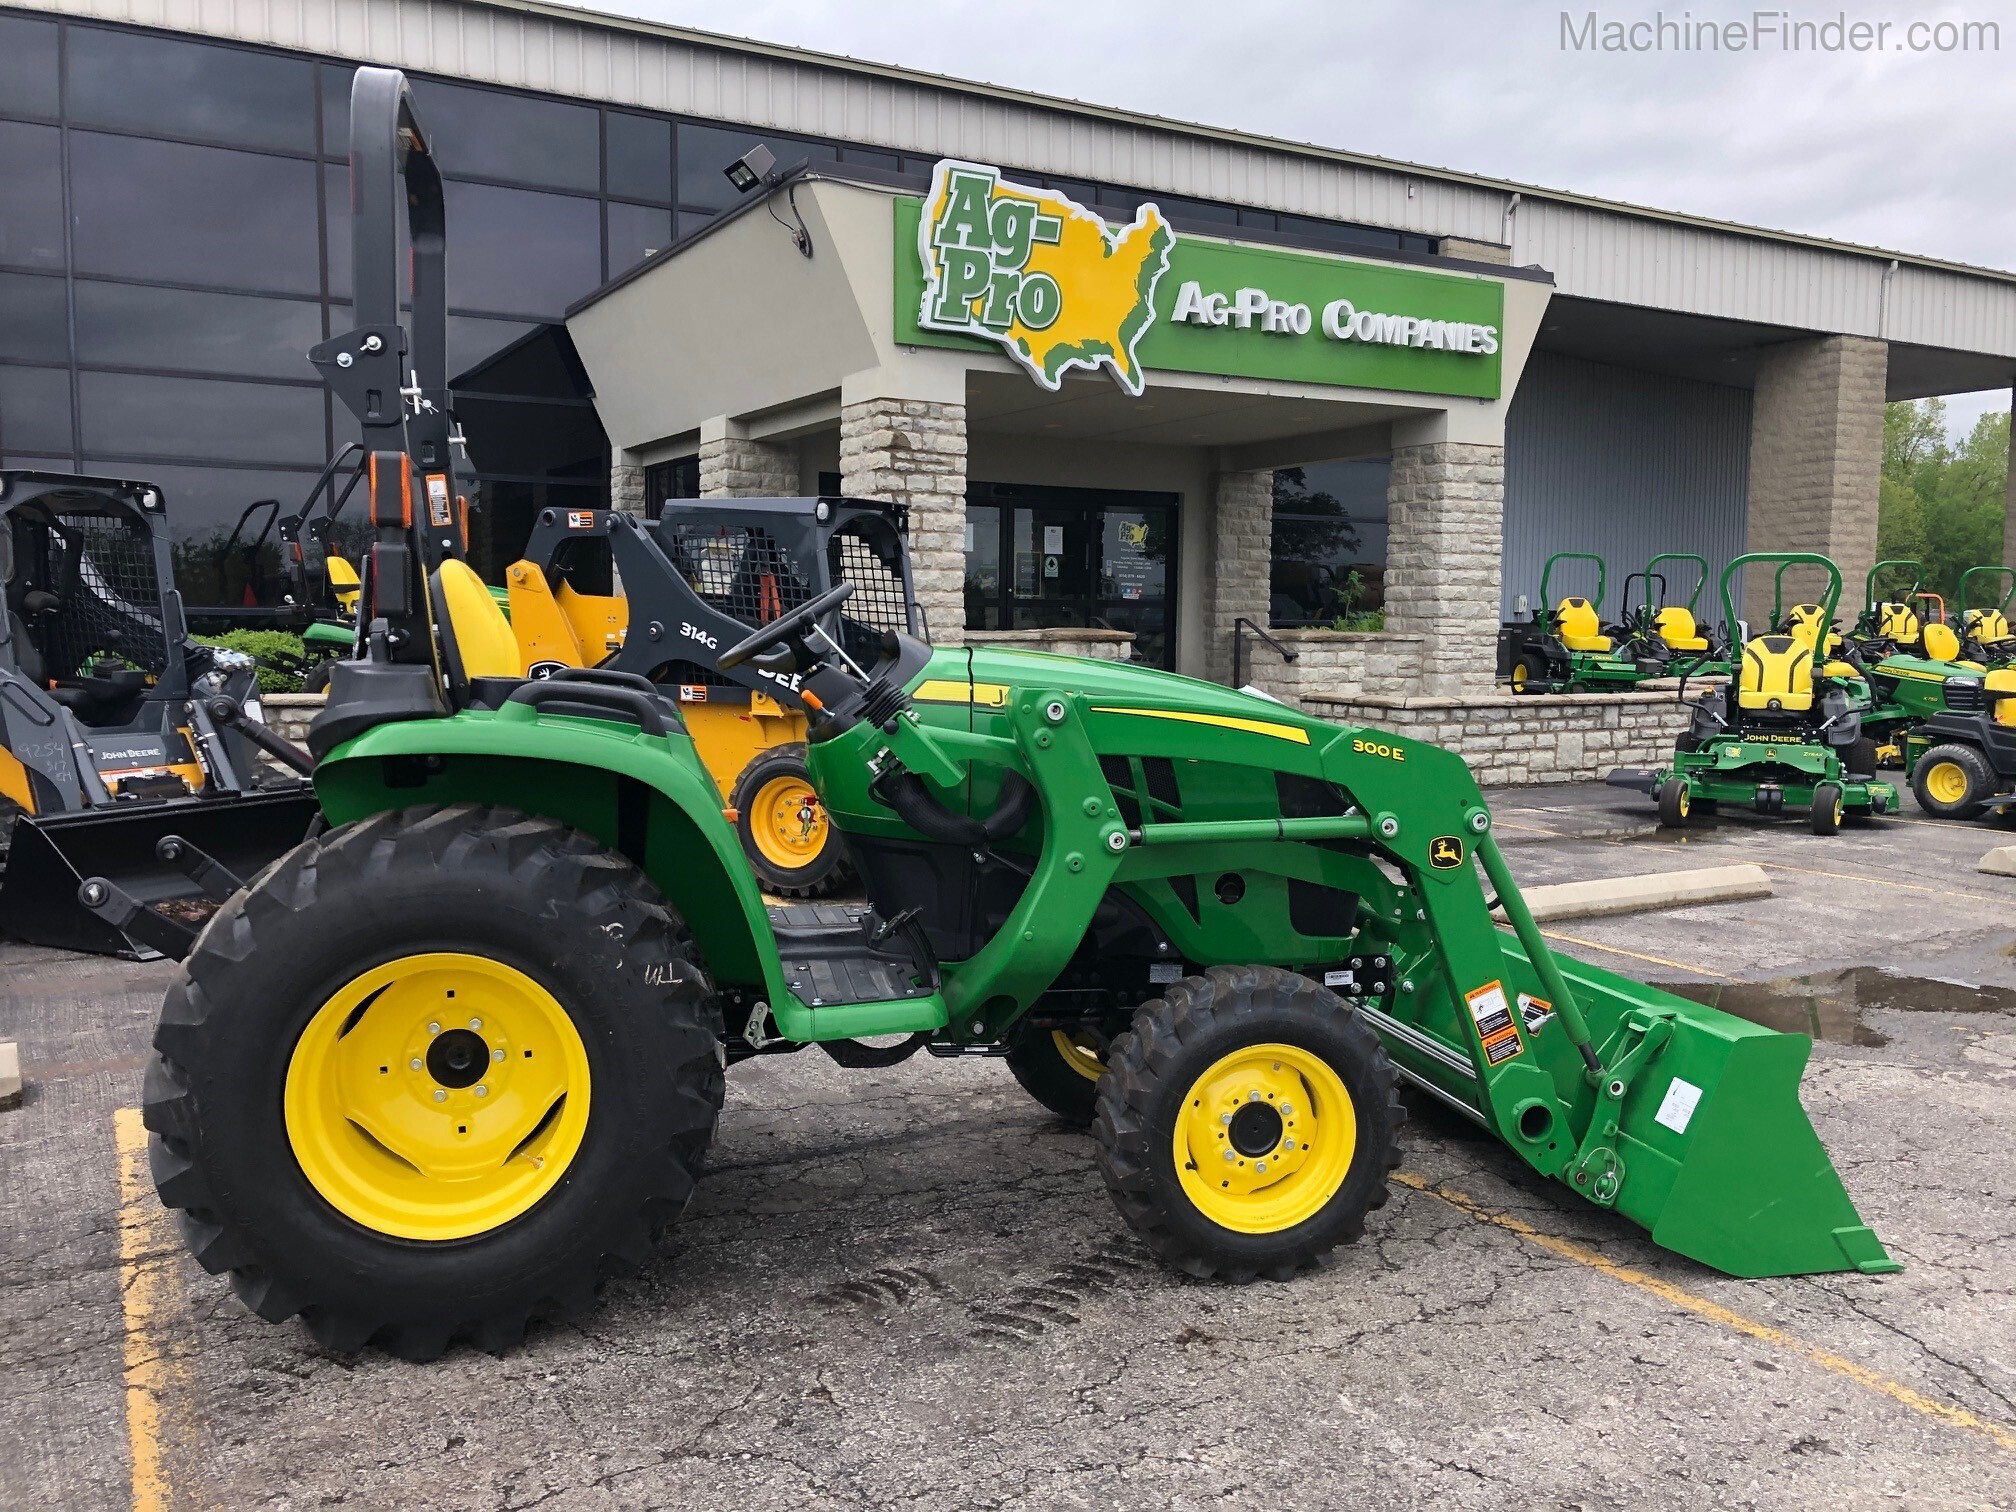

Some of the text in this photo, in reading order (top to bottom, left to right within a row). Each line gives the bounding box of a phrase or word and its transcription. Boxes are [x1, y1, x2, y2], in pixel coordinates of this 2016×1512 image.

[932, 169, 1062, 270] Ag-
[933, 246, 1061, 329] Pro
[1321, 299, 1499, 355] COMPANIES
[680, 622, 718, 650] 314G
[101, 748, 161, 760] JOHN DEERE
[1744, 733, 1802, 743] JOHN DEERE
